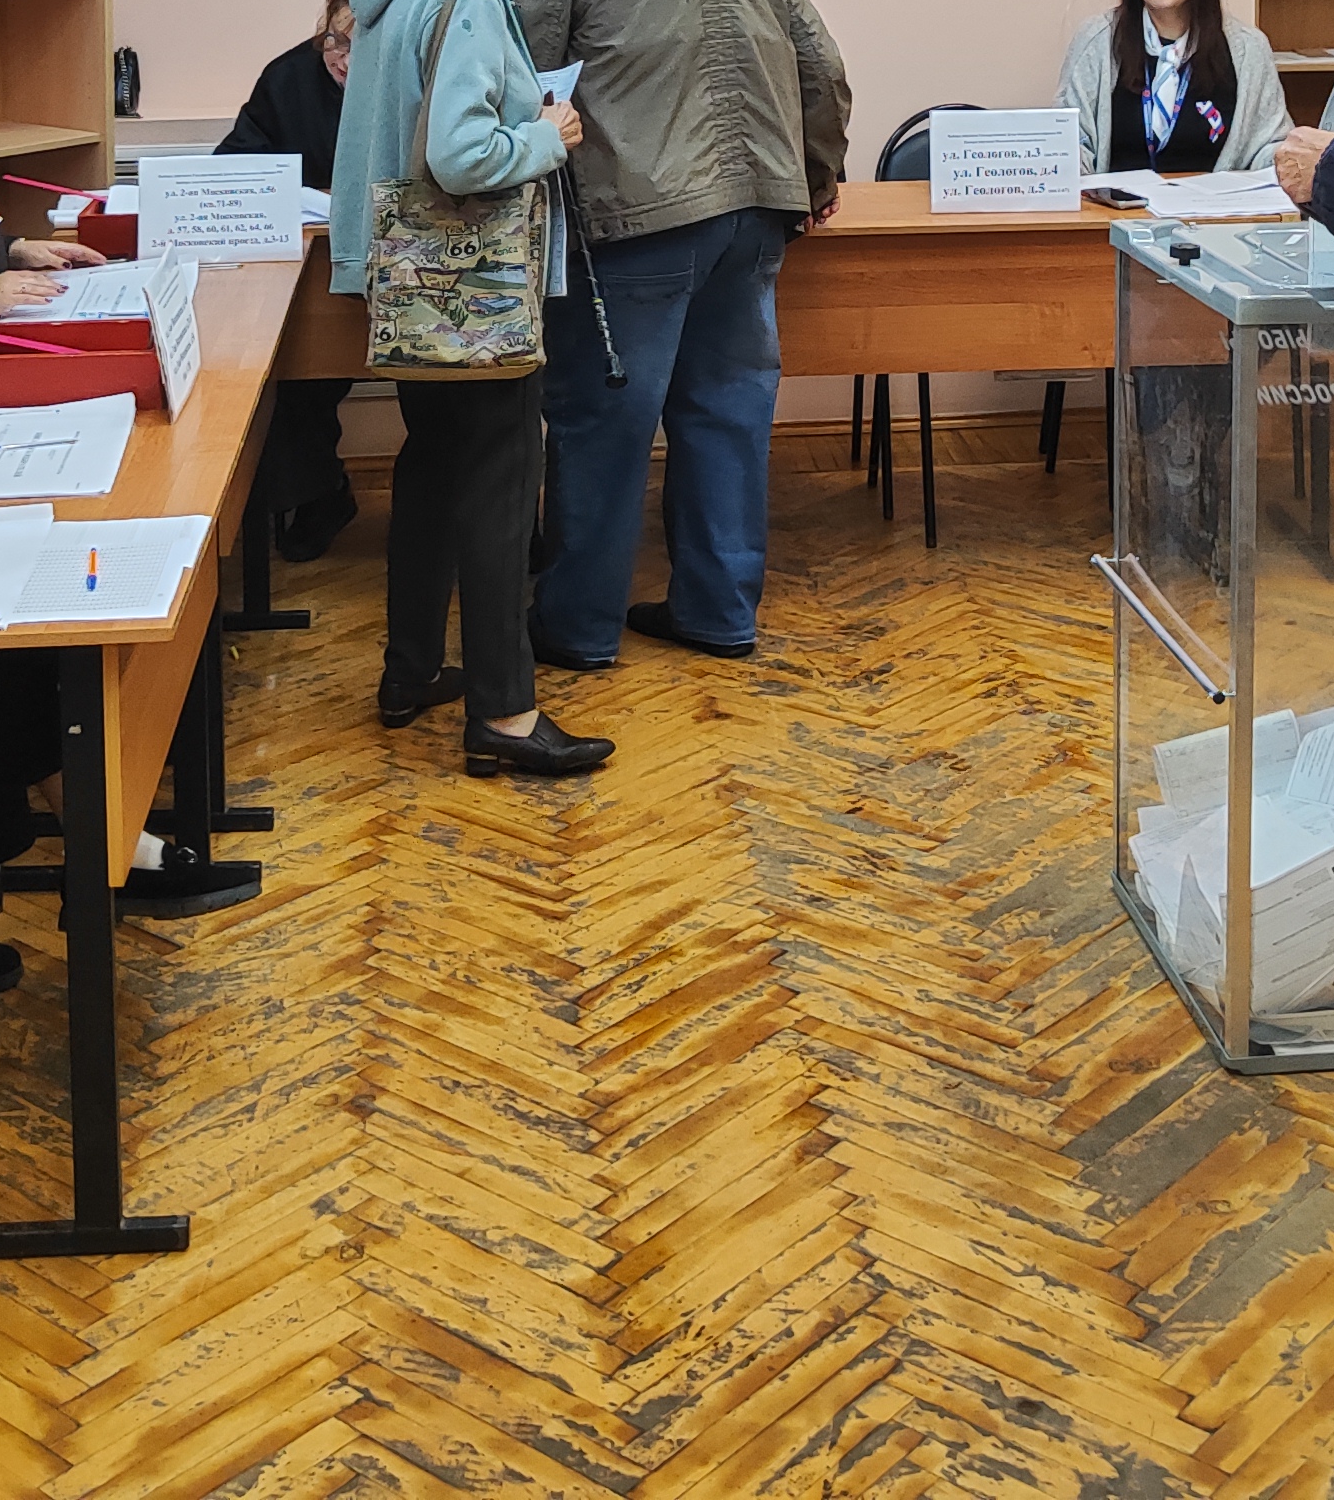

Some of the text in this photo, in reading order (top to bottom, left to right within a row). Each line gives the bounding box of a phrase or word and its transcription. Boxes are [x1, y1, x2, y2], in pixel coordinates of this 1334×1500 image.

[942, 152, 960, 162] ул.
[963, 149, 1021, 159] Геологов,
[953, 164, 1058, 180] ул. Геологов, д.4
[943, 188, 961, 199] ул.
[965, 185, 1025, 196] Геологов,
[1027, 183, 1045, 194] д.5
[450, 240, 477, 256] 66
